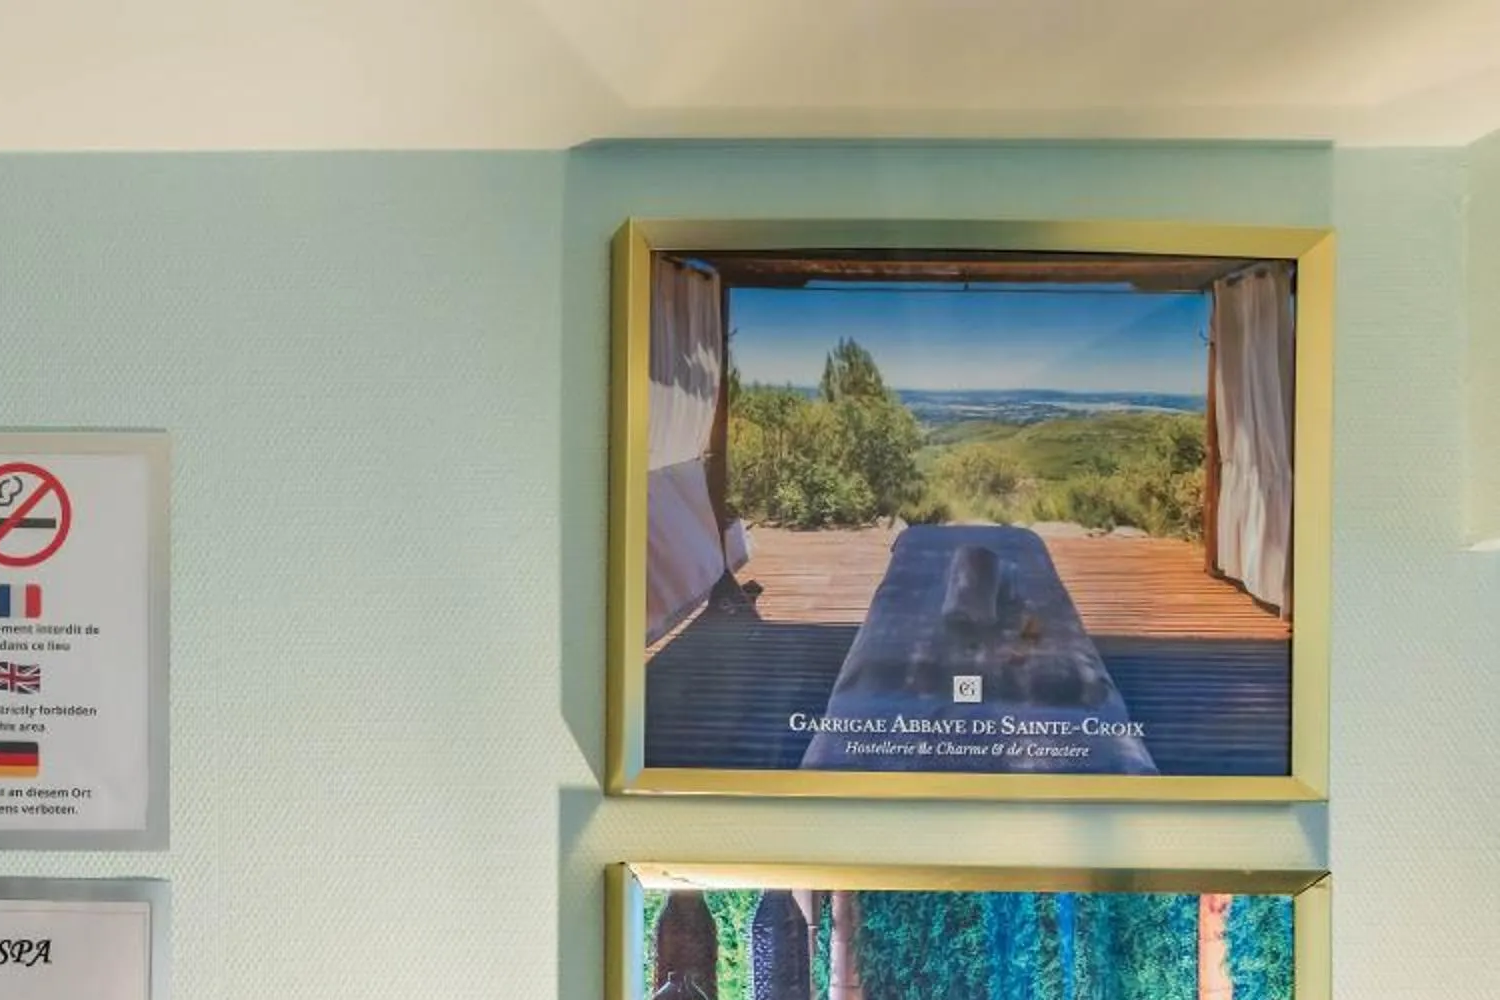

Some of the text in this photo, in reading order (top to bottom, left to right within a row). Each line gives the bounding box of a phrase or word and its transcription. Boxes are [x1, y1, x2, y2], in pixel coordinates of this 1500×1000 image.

[36, 624, 81, 634] interdit
[85, 624, 99, 634] de
[0, 640, 29, 650] dans
[31, 642, 45, 651] ce
[47, 641, 71, 651] lieu
[39, 704, 97, 716] forbidden
[19, 724, 45, 732] area
[789, 713, 1145, 737] GARRIGAE ABBAYE DE SAINTE-CROIX
[846, 741, 914, 755] Hostellerie
[936, 741, 988, 756] Charme
[991, 742, 1005, 756] &
[1008, 741, 1024, 756] de
[8, 788, 22, 797] an
[25, 787, 69, 798] diesem
[71, 787, 91, 798] Ort
[21, 804, 78, 815] verboten.
